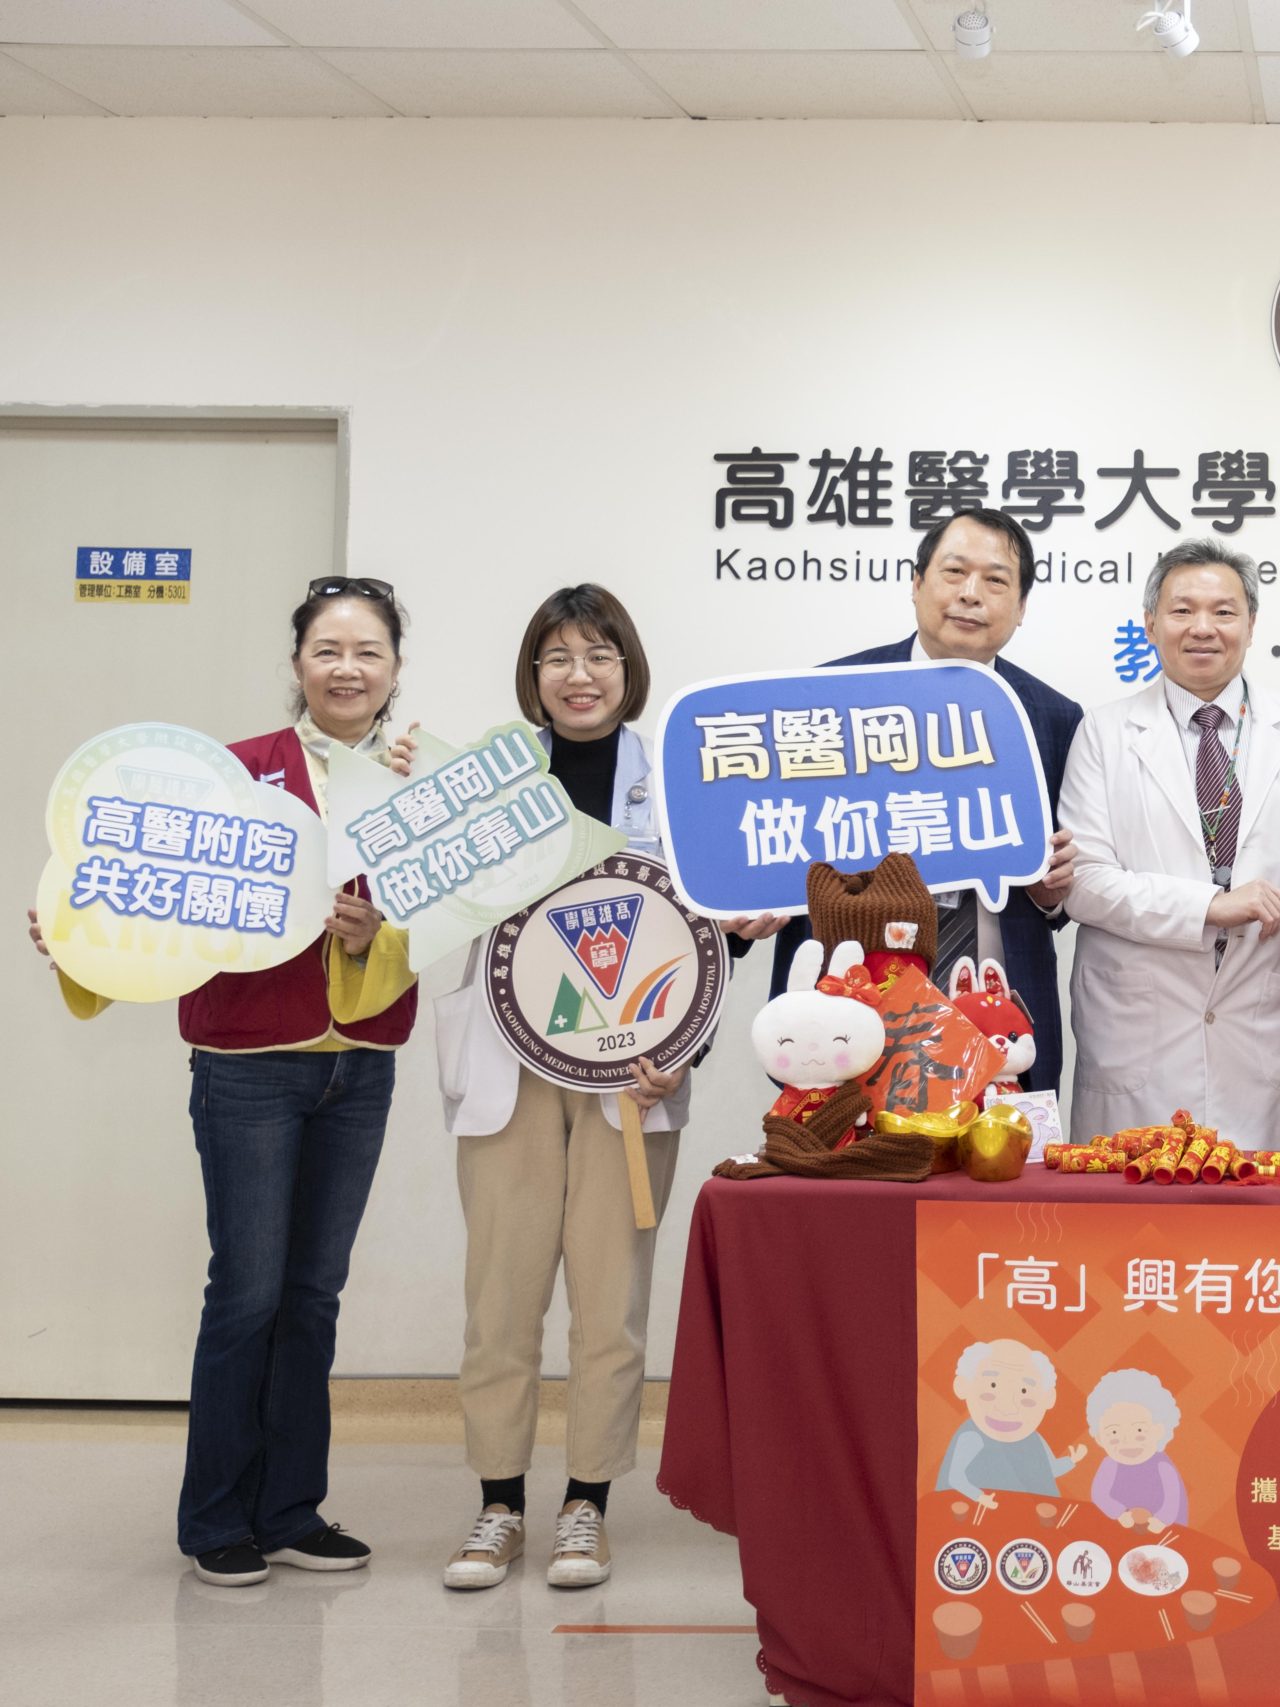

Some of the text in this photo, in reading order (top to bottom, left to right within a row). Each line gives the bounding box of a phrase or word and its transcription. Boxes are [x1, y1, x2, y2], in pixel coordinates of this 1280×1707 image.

[89, 551, 179, 576] 設備室
[715, 548, 916, 585] Kaohsiun
[1034, 552, 1132, 584] dical
[695, 703, 996, 781] 高醫岡山
[351, 732, 537, 863] 高醫岡山
[739, 787, 1024, 866] 做你靠山
[86, 799, 295, 874] 高醫附院
[381, 786, 564, 916] 做你靠山
[74, 858, 286, 934] 共好關懷
[501, 1002, 542, 1057] KAOHSIUNG
[542, 1053, 589, 1078] MEDICAL
[657, 1016, 701, 1062] GANGSHAN
[699, 962, 717, 1016] HOSPITAL
[597, 1032, 636, 1052] 2023
